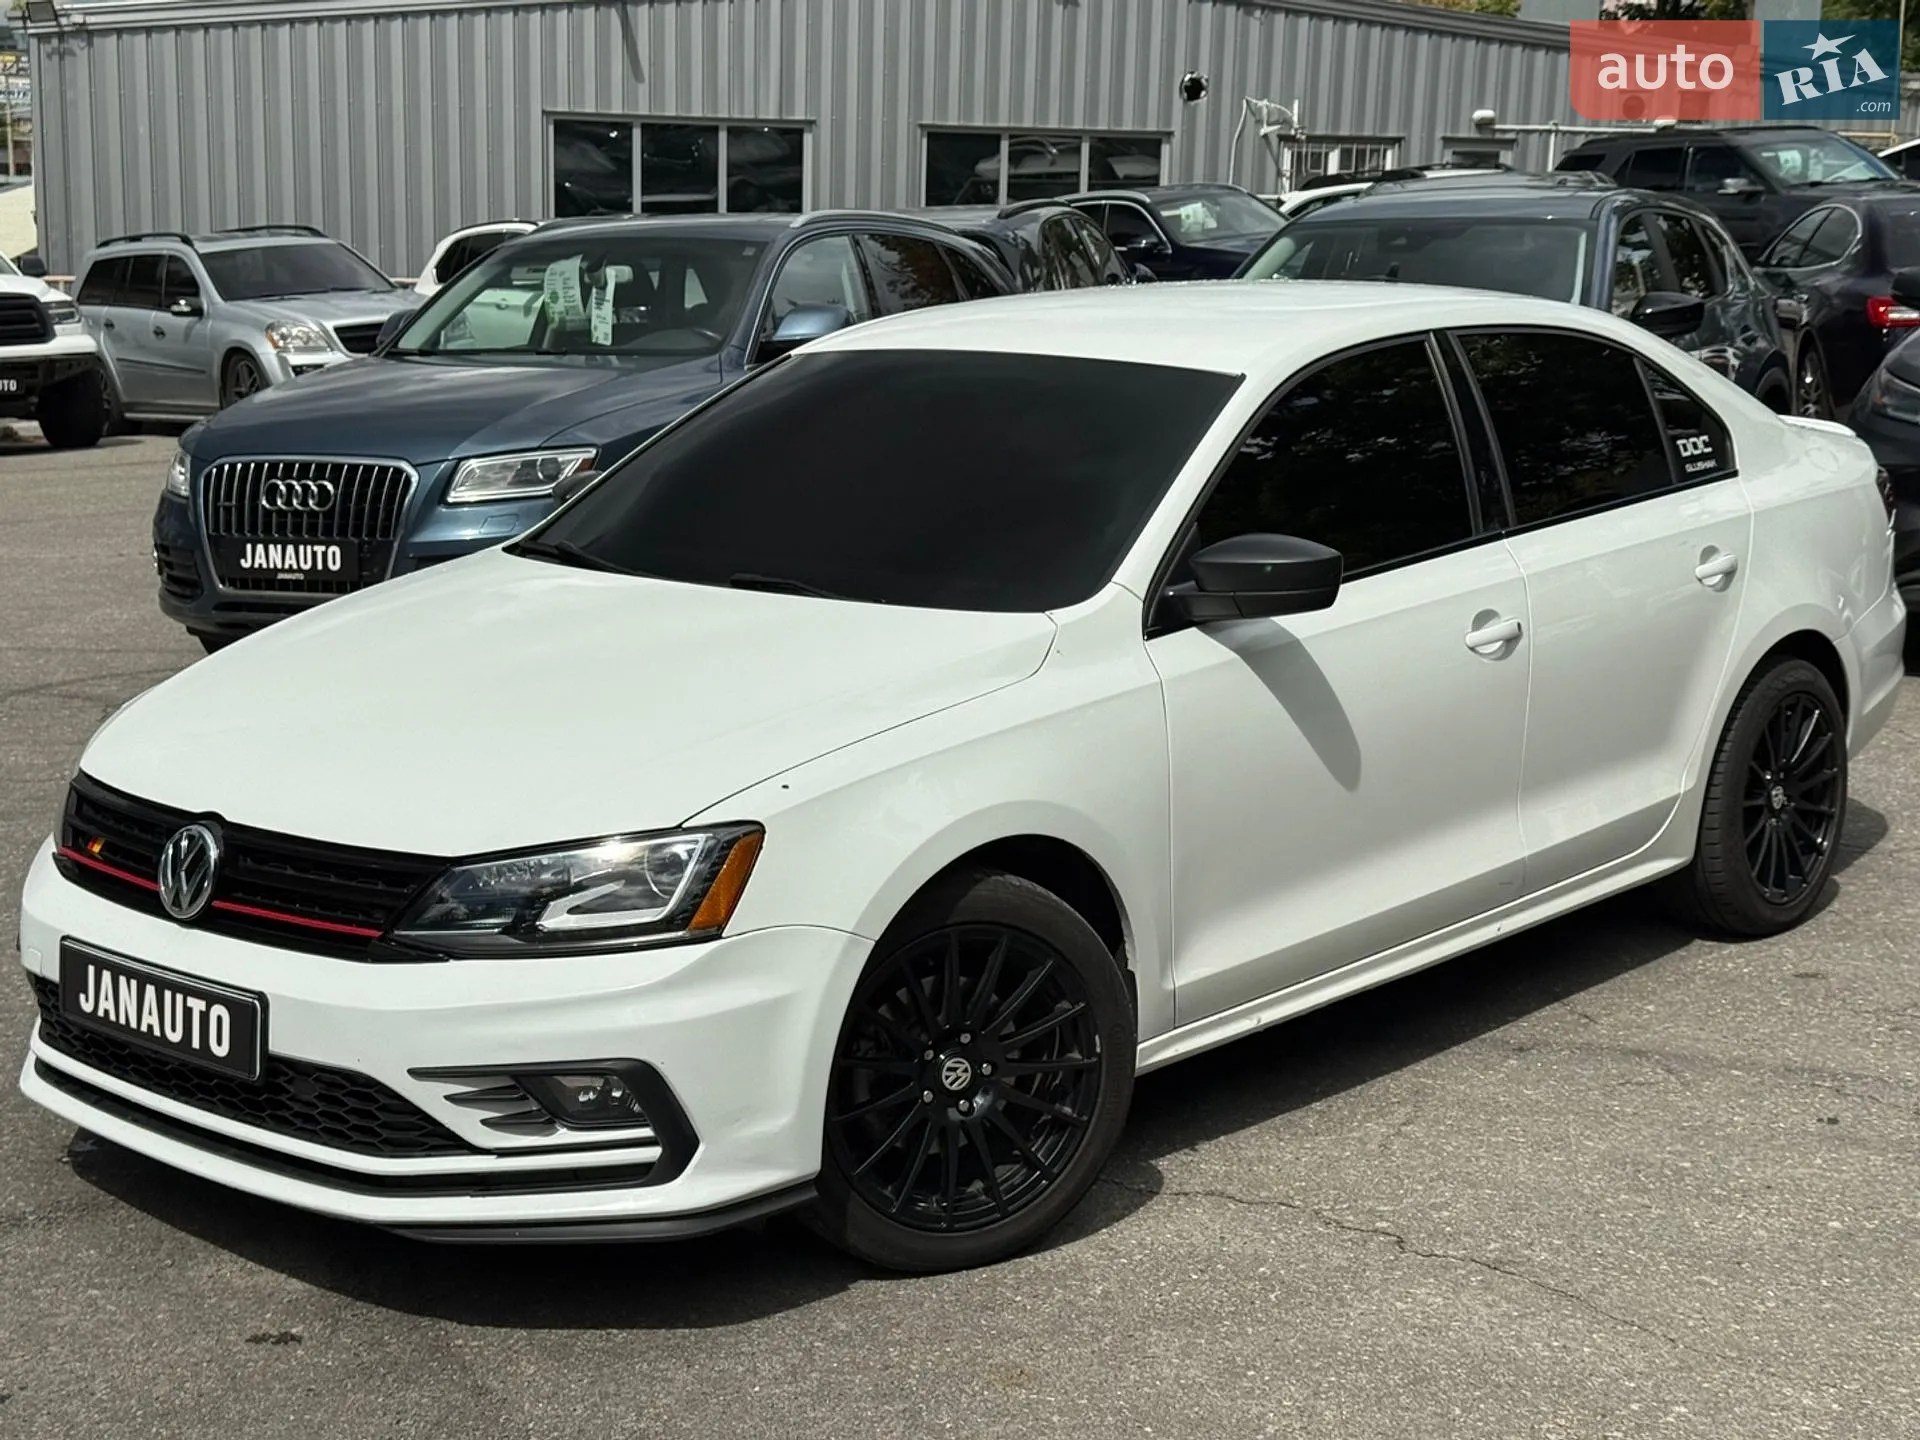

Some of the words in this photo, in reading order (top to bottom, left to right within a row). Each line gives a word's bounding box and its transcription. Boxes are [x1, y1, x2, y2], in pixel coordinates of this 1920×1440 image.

[1676, 435, 1713, 457] DOC
[240, 543, 341, 571] JANAUTO
[79, 964, 231, 1058] JANAUTO
